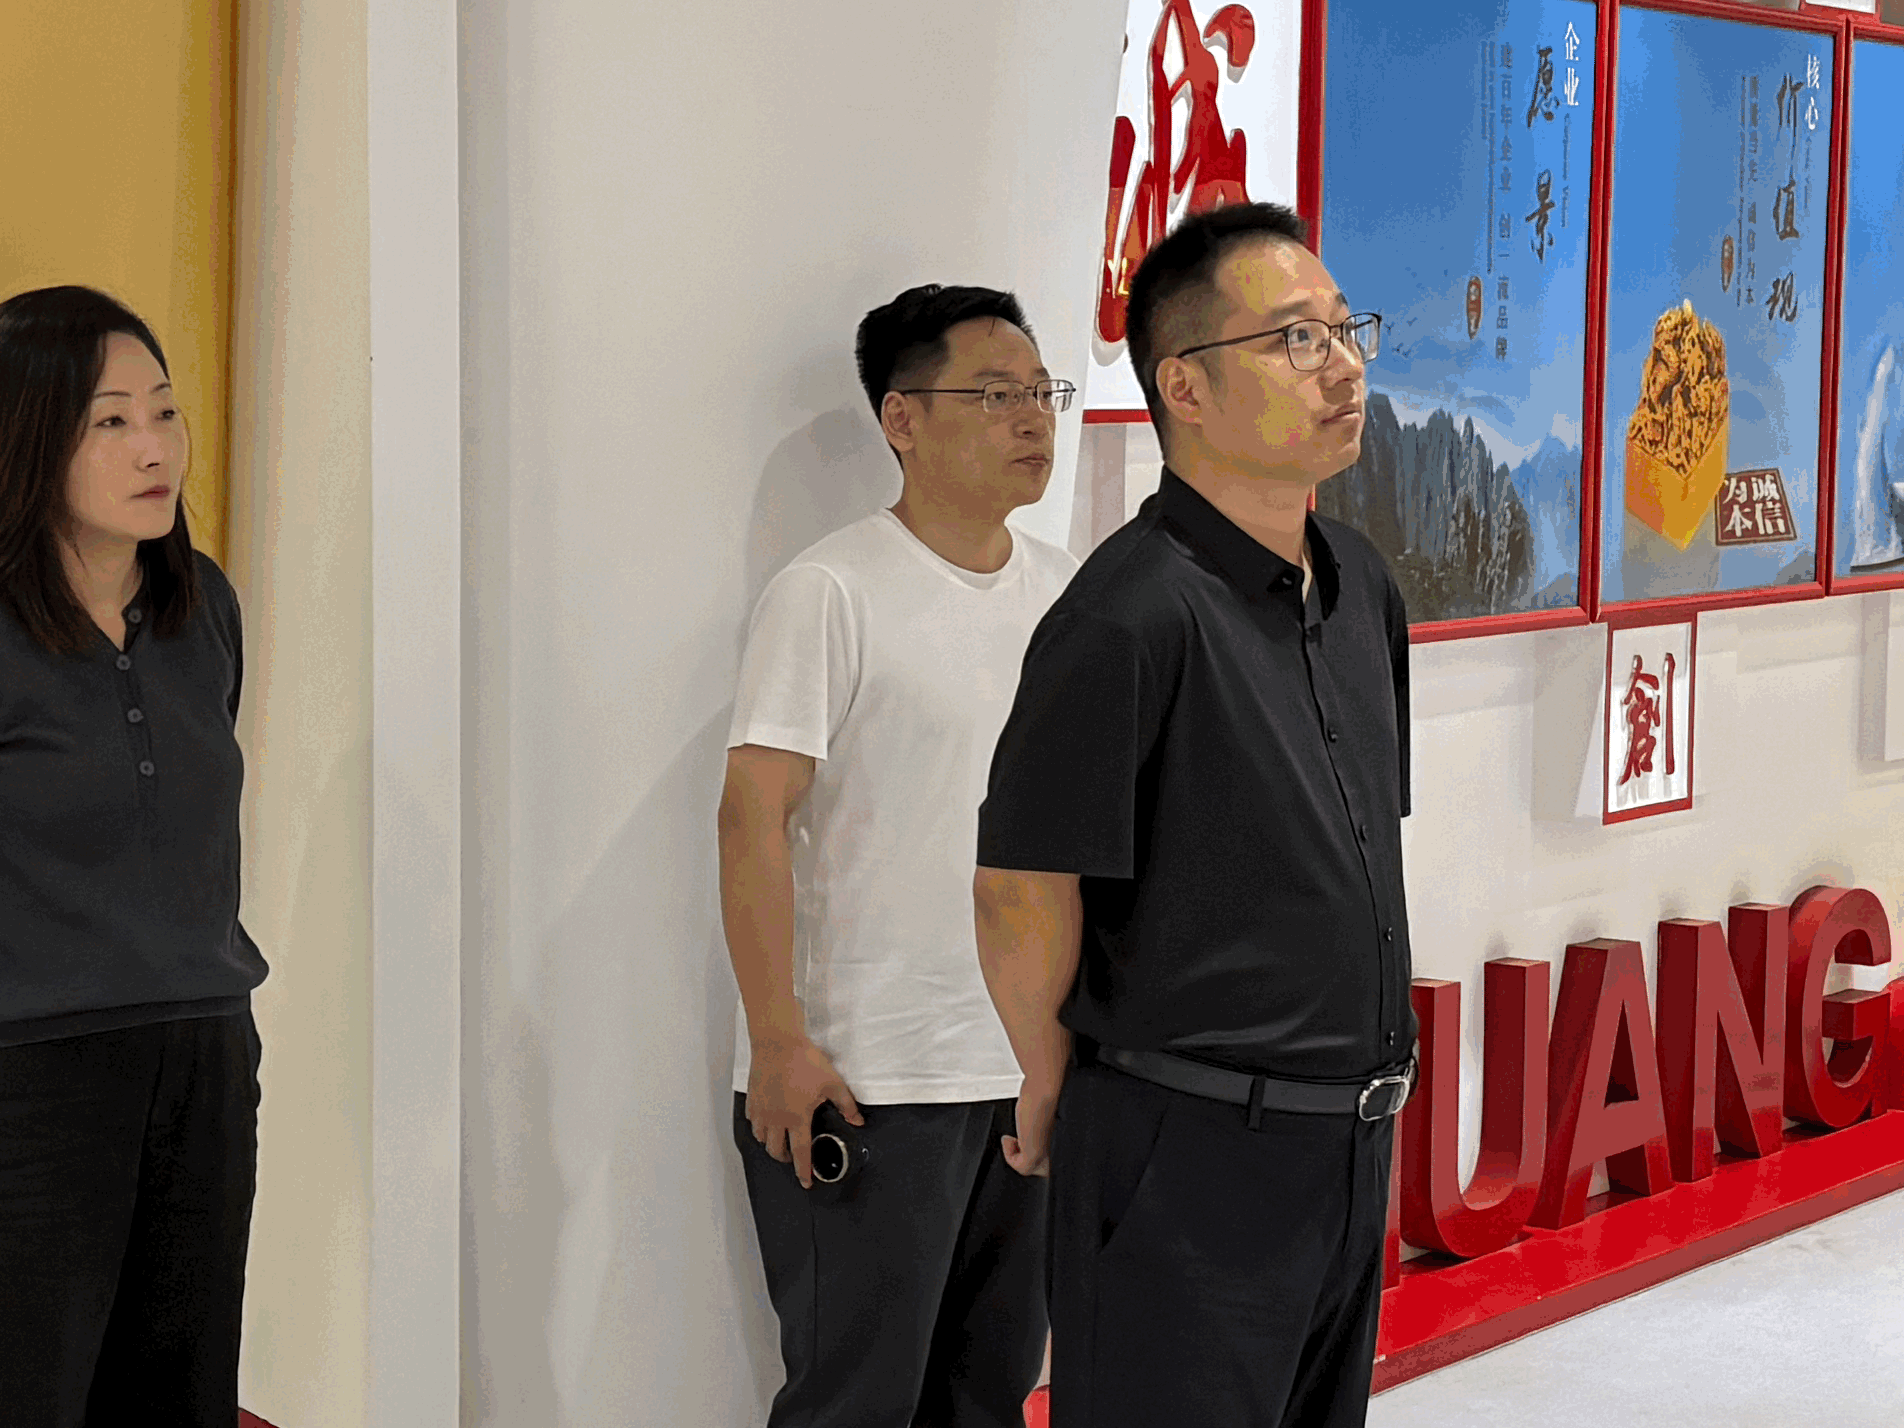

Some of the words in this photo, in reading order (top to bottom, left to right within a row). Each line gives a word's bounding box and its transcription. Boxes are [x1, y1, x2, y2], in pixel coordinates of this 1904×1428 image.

[1564, 21, 1580, 106] 企业
[1804, 54, 1819, 130] 核心
[1525, 46, 1559, 263] 愿景
[1382, 885, 1893, 1290] UANG
